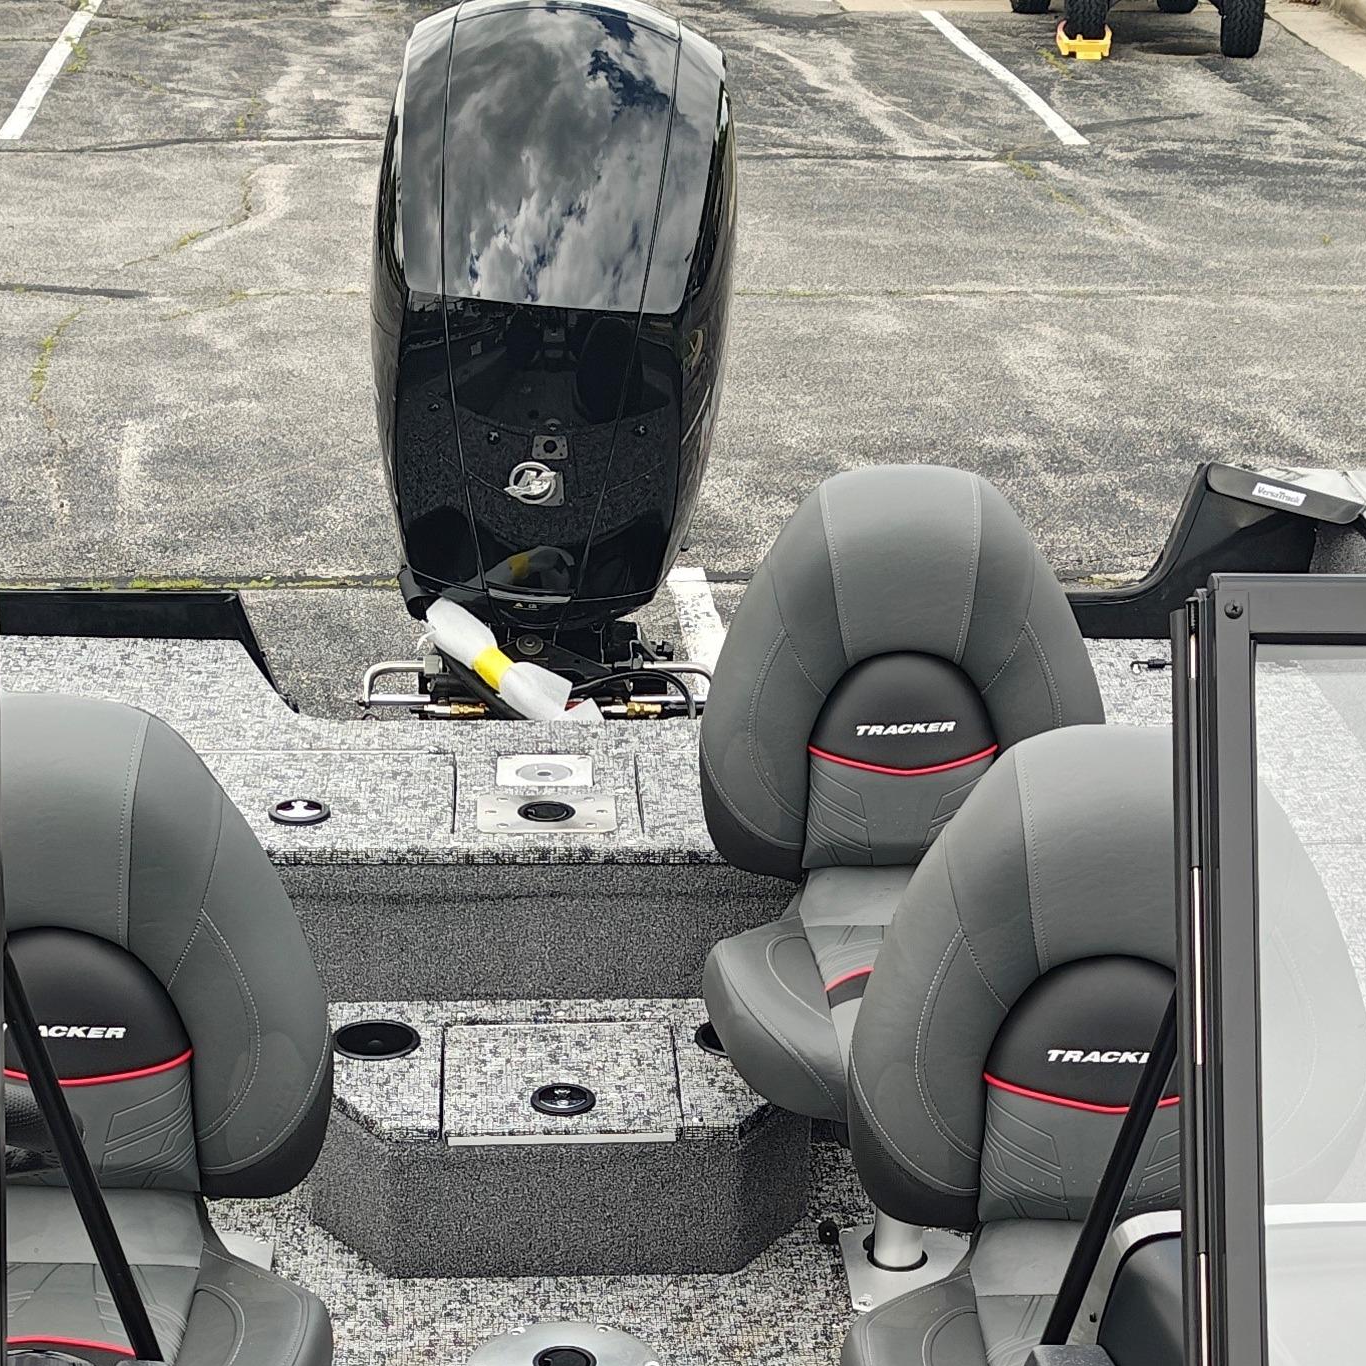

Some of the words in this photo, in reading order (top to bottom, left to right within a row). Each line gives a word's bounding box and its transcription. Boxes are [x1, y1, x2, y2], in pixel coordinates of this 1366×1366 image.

[1257, 486, 1300, 504] VersaTrack
[856, 721, 956, 736] TRACKER
[1047, 1049, 1151, 1064] TRACK
